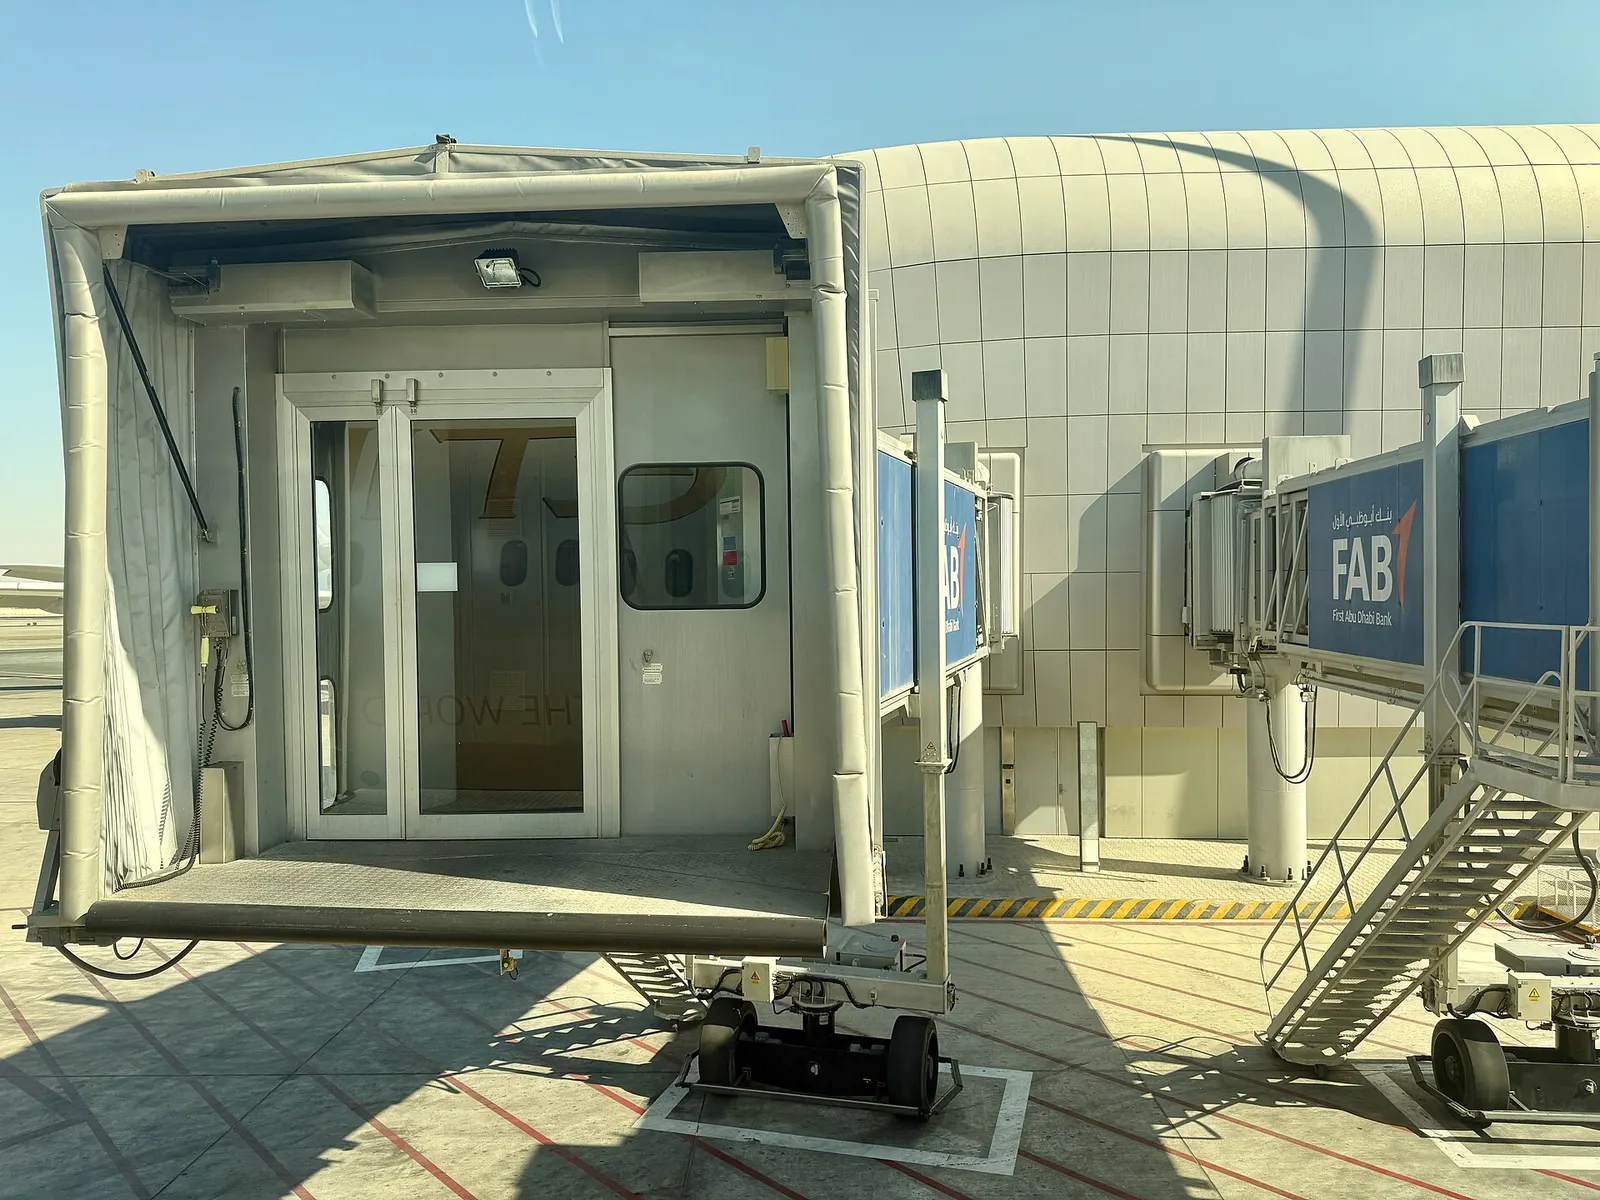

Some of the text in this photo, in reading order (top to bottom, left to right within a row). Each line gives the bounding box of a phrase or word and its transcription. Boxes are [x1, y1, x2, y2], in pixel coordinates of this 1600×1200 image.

[1332, 504, 1393, 531] بنك أبوظبي الأول
[944, 544, 960, 610] AB
[1332, 534, 1393, 602] FAB
[1332, 608, 1393, 626] First Abu Dhabi Bank
